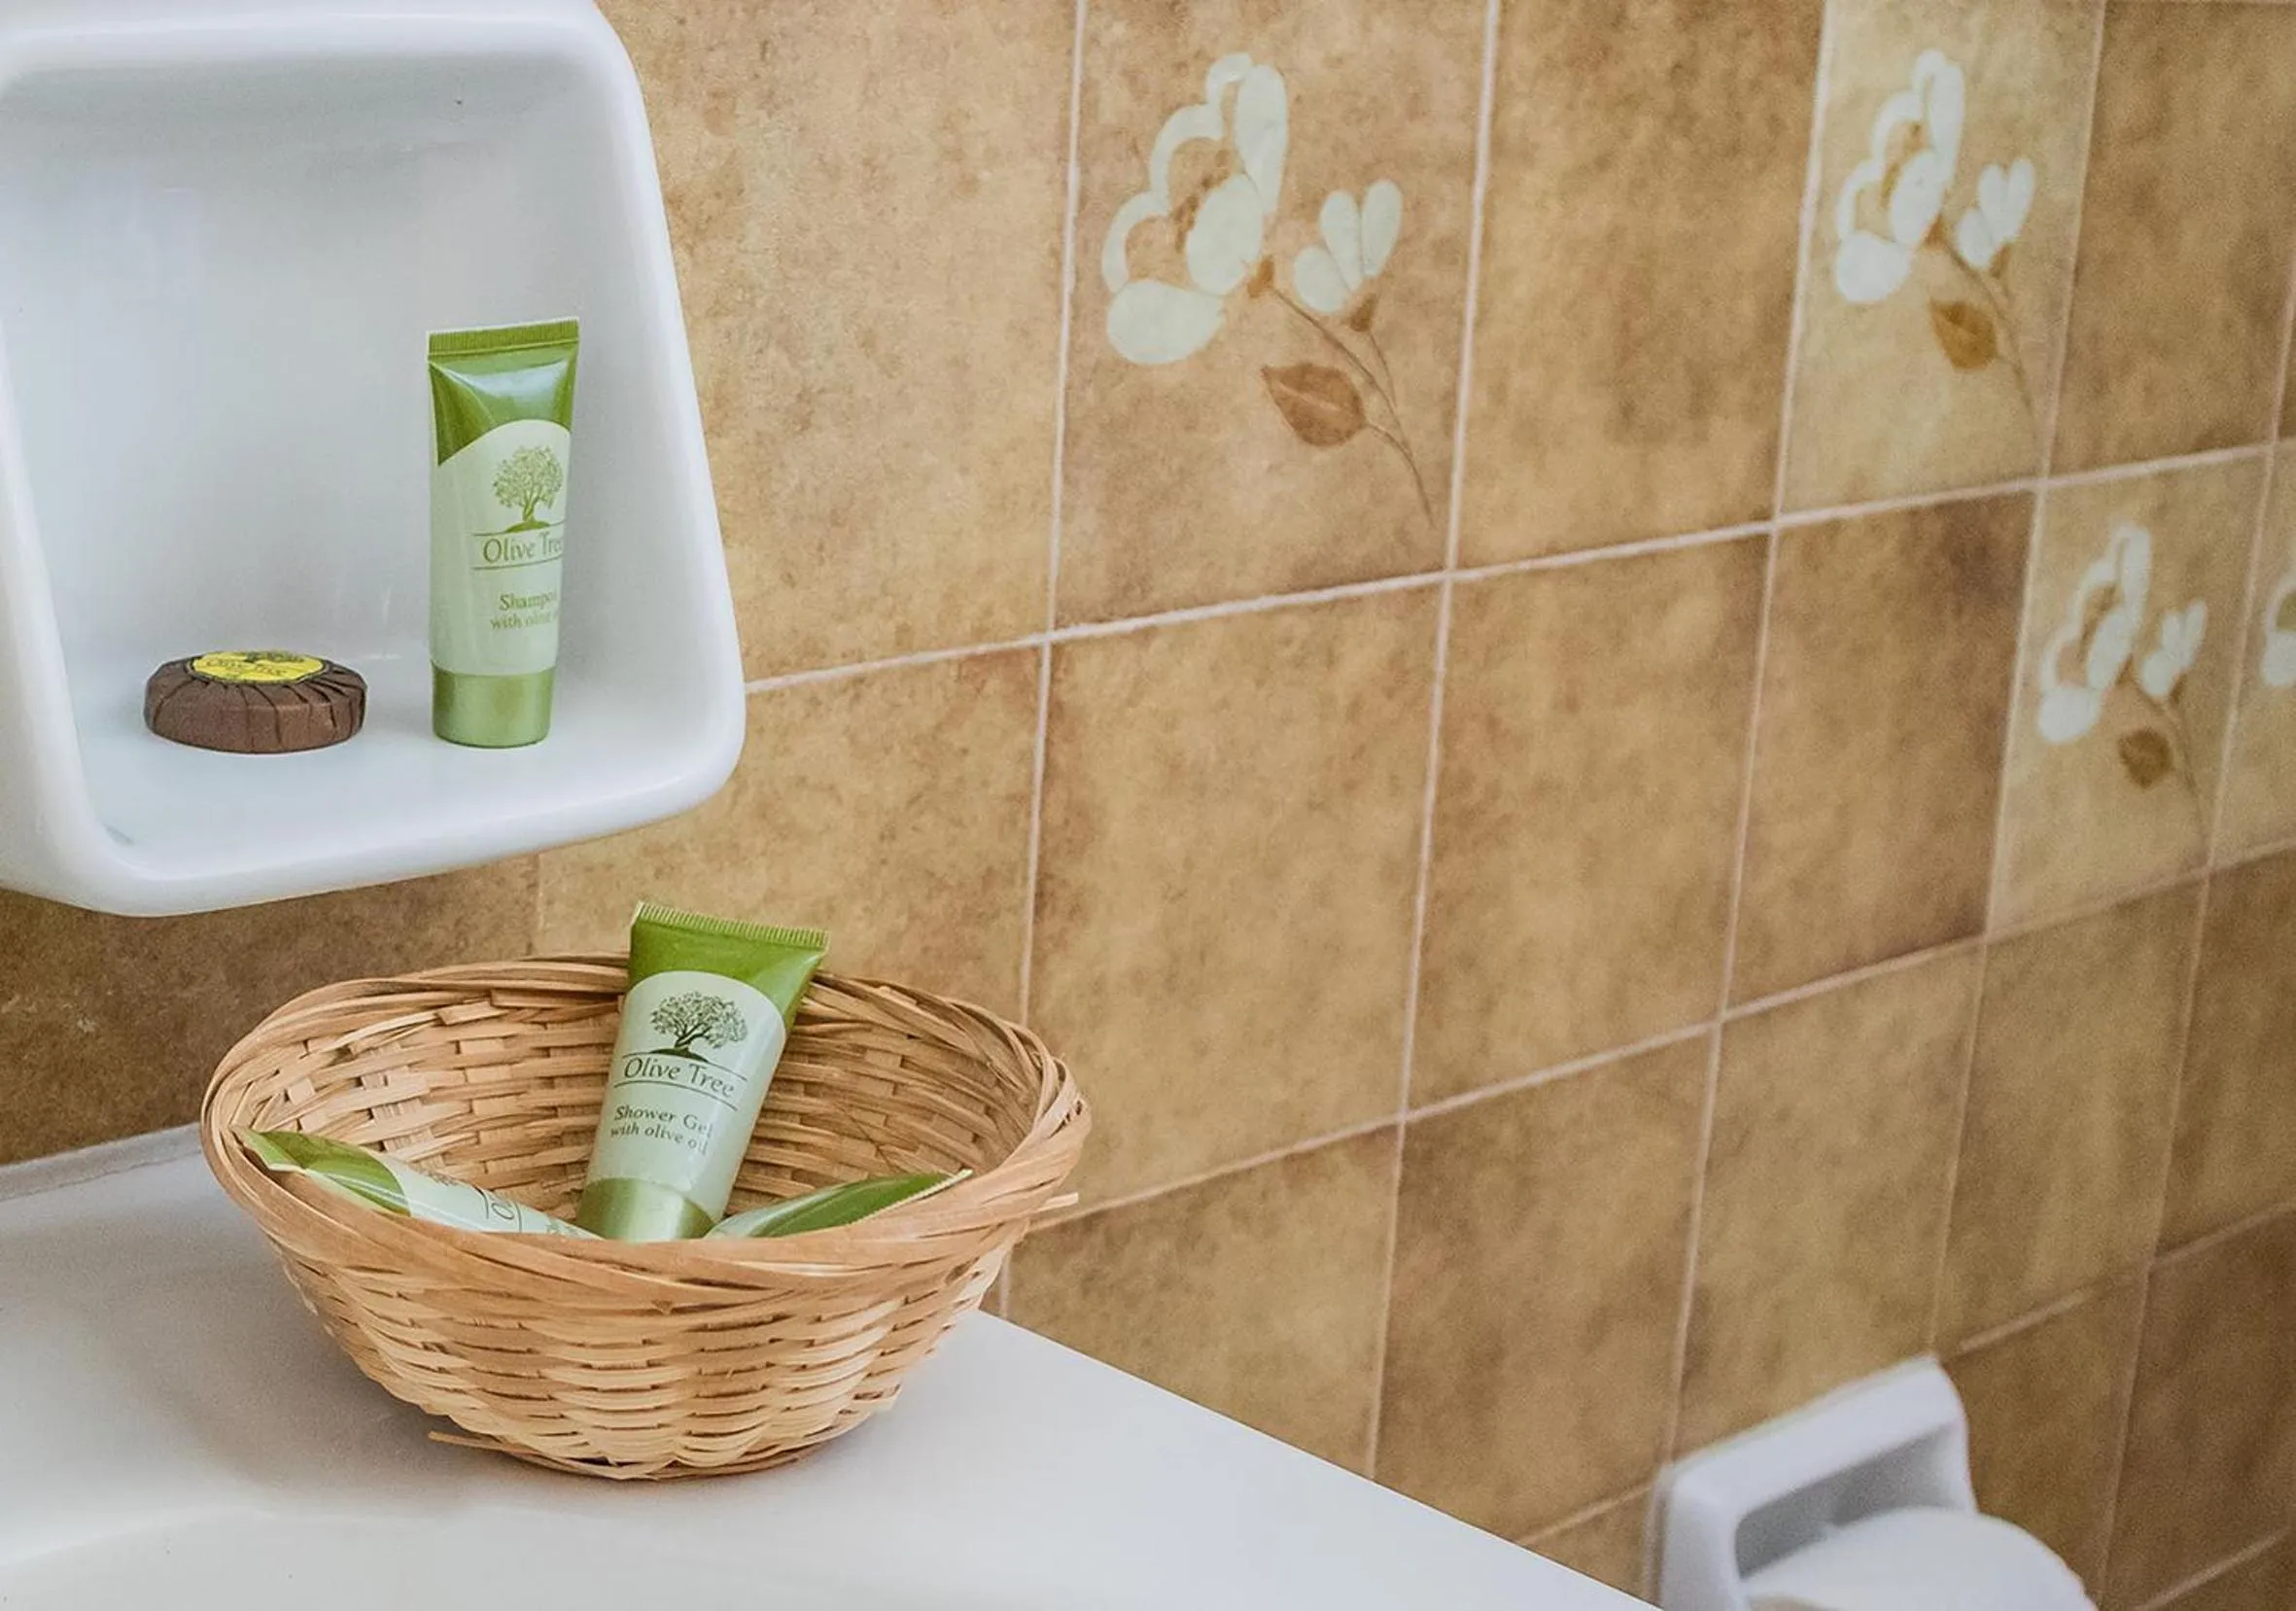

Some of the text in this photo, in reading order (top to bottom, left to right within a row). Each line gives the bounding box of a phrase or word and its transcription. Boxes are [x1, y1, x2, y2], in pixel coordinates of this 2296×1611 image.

[483, 538, 536, 563] Olive
[490, 613, 522, 630] with
[624, 1057, 735, 1098] Olive Tree
[614, 1104, 713, 1138] Shower Gel
[610, 1122, 709, 1156] with olive oil
